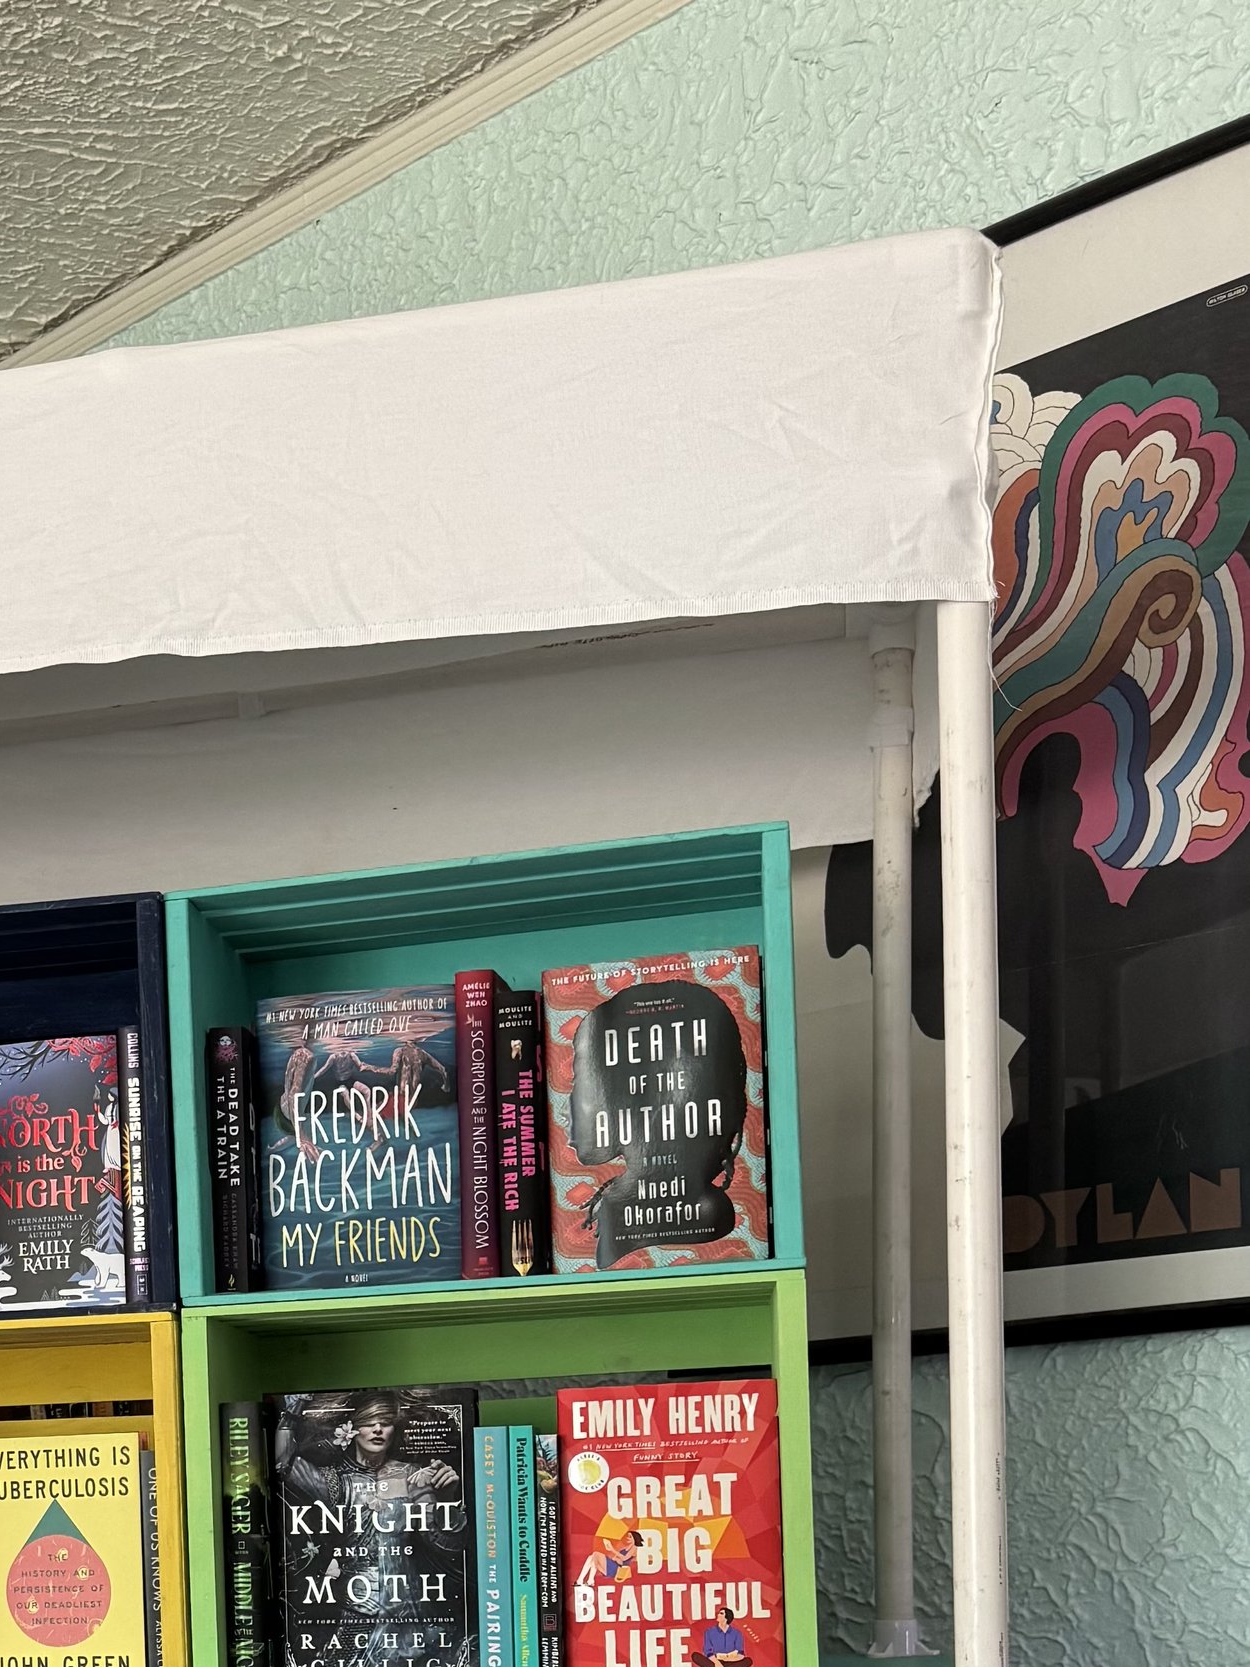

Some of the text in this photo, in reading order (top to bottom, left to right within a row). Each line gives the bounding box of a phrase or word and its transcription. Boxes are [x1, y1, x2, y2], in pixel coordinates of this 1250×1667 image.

[551, 954, 751, 986] THE FUTURE OF STORYTELLING IS HERE
[279, 1009, 295, 1022] NEW
[299, 1007, 320, 1020] YORK
[324, 1005, 346, 1018] TIMES
[350, 1001, 398, 1015] BESTSELLING
[401, 998, 434, 1012] AUTHOR
[437, 997, 447, 1009] OF
[498, 1006, 532, 1014] MOULITE
[498, 1020, 532, 1028] MOULITE
[301, 1015, 412, 1040] A MAN CALLED OVE
[604, 1018, 707, 1067] DEATH
[126, 1032, 139, 1070] COLLINS
[470, 1030, 486, 1105] SCORPION
[629, 1070, 685, 1095] OF THE
[128, 1077, 142, 1142] SUNRISE
[228, 1088, 239, 1136] DEAD
[293, 1083, 423, 1147] FREDRIK
[499, 1102, 515, 1130] ATE
[519, 1069, 535, 1178] THE SUMMER
[595, 1099, 723, 1149] AUTHOR
[216, 1076, 228, 1179] THE A TRAIN
[17, 1154, 65, 1173] is the
[132, 1145, 141, 1159] ON
[229, 1141, 240, 1187] TAKE
[472, 1126, 487, 1171] NIGHT
[502, 1136, 517, 1167] THE
[132, 1160, 142, 1182] THE
[268, 1142, 452, 1218] BACKMAN
[504, 1172, 519, 1211] RICH
[637, 1175, 686, 1200] Nnedi
[7, 1214, 84, 1226] INTERNATIONALLY
[131, 1186, 146, 1252] REAPING
[473, 1174, 490, 1249] BLOSSOM
[624, 1201, 701, 1227] Okorafor
[1002, 1167, 1242, 1254] DYLAN
[18, 1223, 73, 1232] BESTSELLING
[28, 1231, 63, 1239] AUTHOR
[282, 1216, 441, 1268] MY FRIENDS
[19, 1239, 74, 1257] EMILY
[23, 1255, 70, 1274] RATH
[571, 1392, 759, 1440] EMILY HENRY
[112, 1445, 131, 1466] IS
[484, 1435, 494, 1476] CASEY
[633, 1451, 699, 1462] FUNNY STORY
[229, 1417, 251, 1535] RILEY SAGER
[353, 1482, 389, 1492] THE
[516, 1437, 530, 1583] Patricia Wants to Cuddle
[606, 1472, 738, 1520] GREAT
[289, 1500, 462, 1535] KNIGHT
[48, 1553, 67, 1562] THE
[333, 1545, 413, 1557] AND THE
[636, 1527, 713, 1574] BIG
[21, 1568, 95, 1578] HISTORY AND
[13, 1584, 104, 1594] PERSISTENCE OF
[233, 1562, 254, 1627] MIDDLE
[302, 1574, 447, 1604] MOTH
[573, 1581, 771, 1623] BEAUTIFUL
[16, 1600, 102, 1610] OUR DEADLIEST
[486, 1564, 502, 1667] THE PAIRING
[31, 1617, 89, 1626] INFECTION
[300, 1632, 452, 1649] RACHEL
